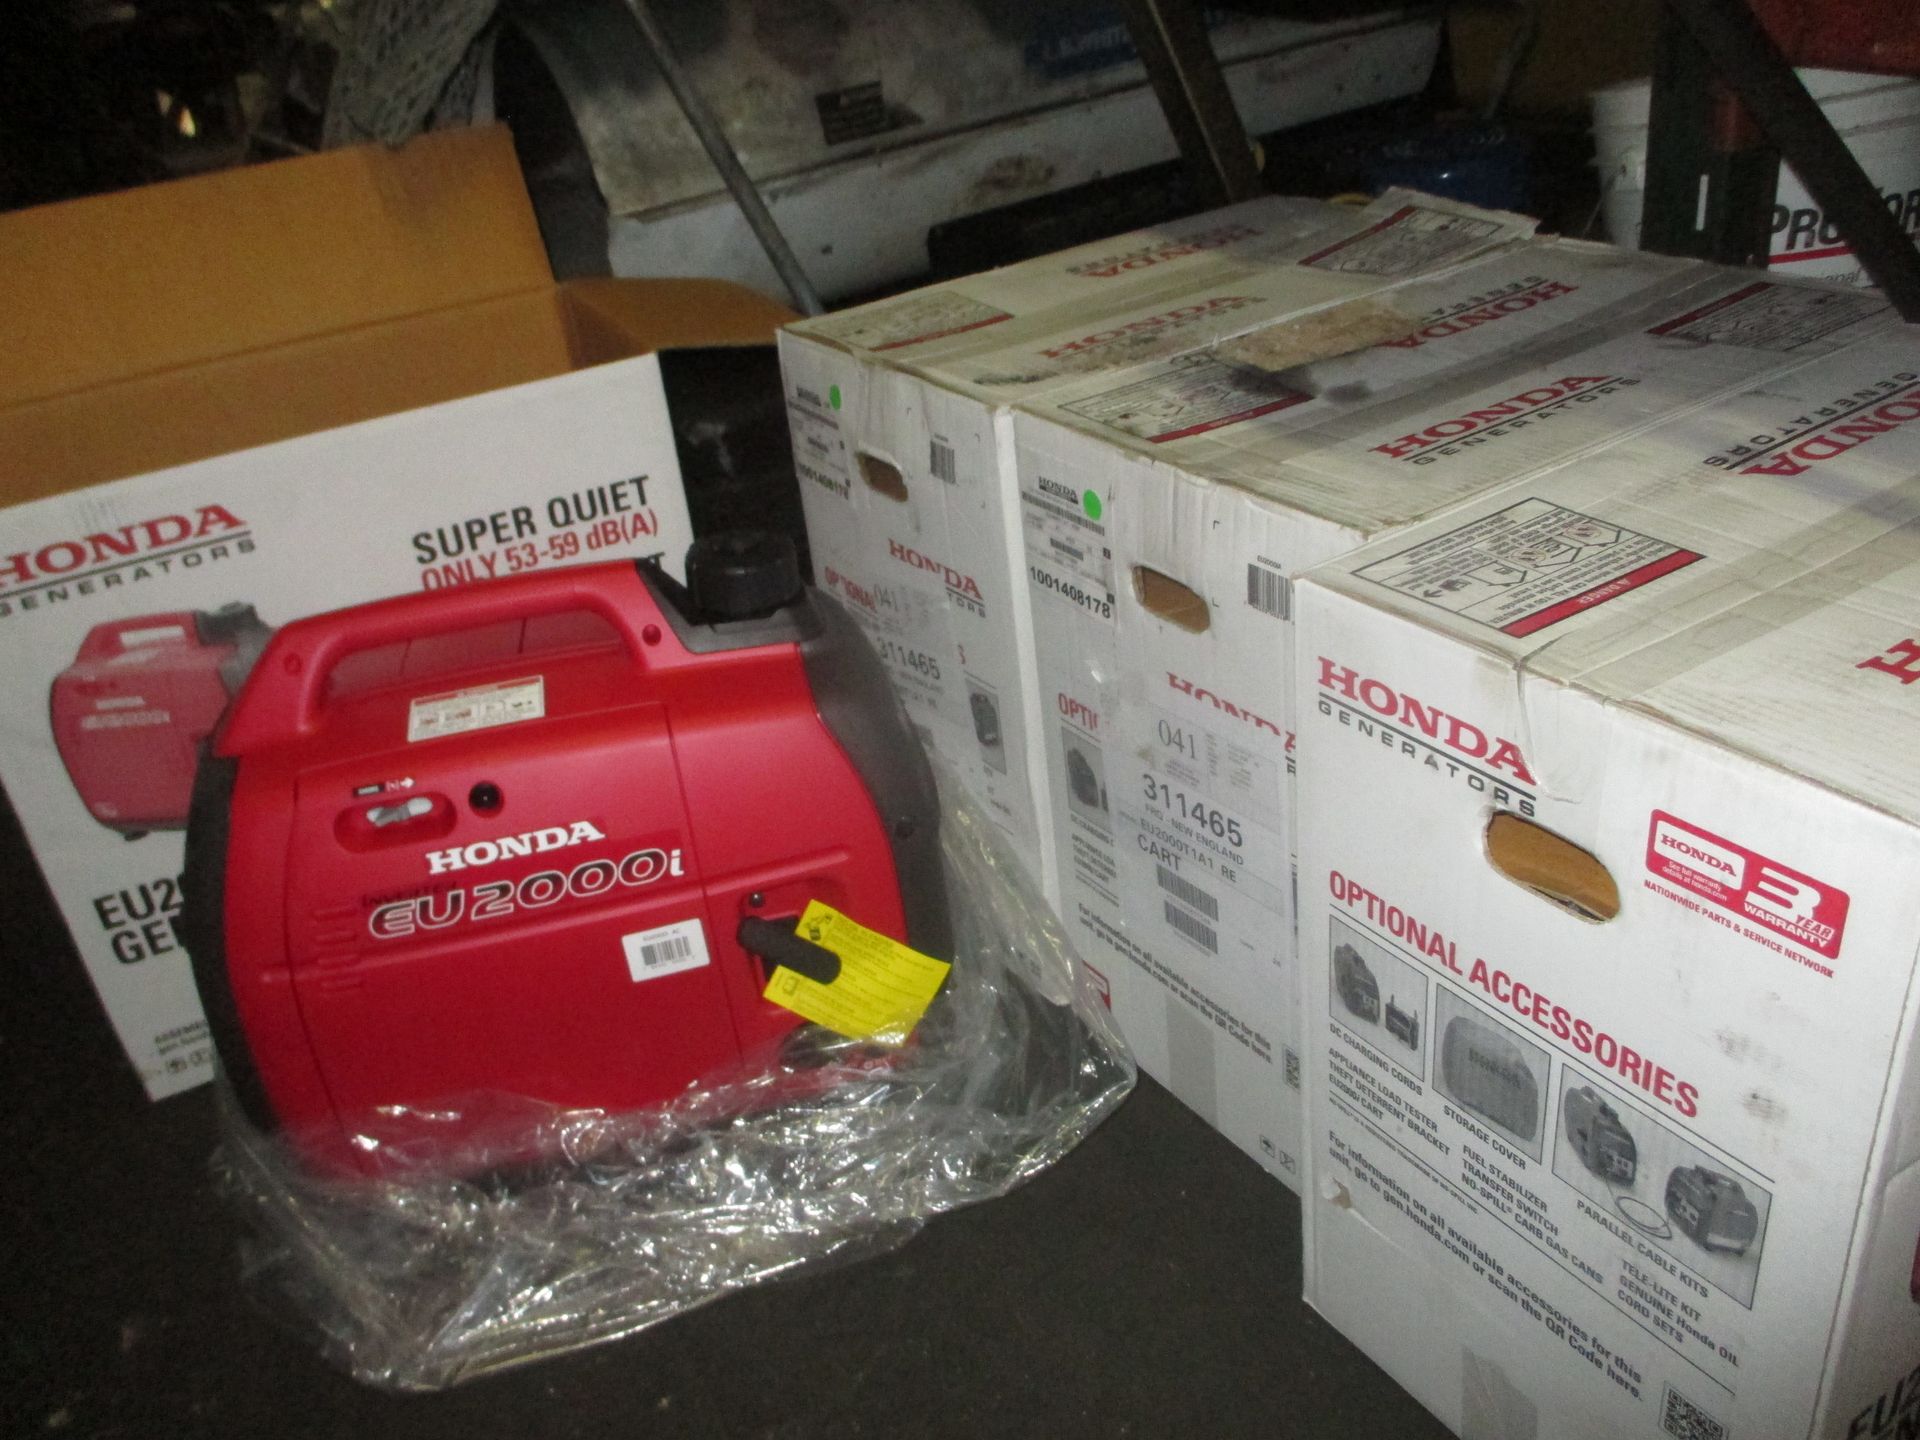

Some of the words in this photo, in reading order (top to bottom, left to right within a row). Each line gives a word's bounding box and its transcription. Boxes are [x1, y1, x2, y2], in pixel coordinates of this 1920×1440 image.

[1371, 282, 1578, 349] HONDA
[1368, 375, 1612, 459] HONDA
[1412, 378, 1641, 466] GENERATORS
[1703, 373, 1918, 468] GENERATORS
[1738, 391, 1920, 477] ONDA
[412, 506, 538, 565] SUPER
[547, 474, 649, 529] QUIET
[1038, 476, 1079, 505] HONDA
[421, 551, 498, 592] ONLY
[504, 531, 580, 572] 53-59
[586, 507, 659, 551] dB(A)
[889, 538, 984, 601] HONDA
[1031, 566, 1111, 620] 1001408178
[1158, 718, 1197, 760] 041
[1317, 655, 1537, 786] HONDA
[1318, 698, 1537, 818] GENERATORS
[425, 820, 606, 875] HONDA
[1143, 773, 1243, 848] 311465
[1137, 834, 1182, 871] CART
[1196, 832, 1244, 866] ENGLAND
[1221, 864, 1237, 883] RE
[1661, 833, 1737, 877] HONDA
[368, 848, 685, 940] EU2000i
[1644, 878, 1699, 913] NATIONWIDE
[1702, 907, 1731, 928] PARTS
[1733, 922, 1741, 933] &
[1743, 927, 1782, 953] SERVICE
[1784, 947, 1833, 978] NETWORK
[1743, 902, 1828, 949] WARRANTY
[1796, 913, 1832, 940] YEAR
[1330, 870, 1463, 976] OPTIONAL
[1467, 955, 1701, 1120] ACCESSORIES
[1329, 1046, 1375, 1087] APPLIANCE
[1378, 1081, 1401, 1106] LOAD
[1404, 1100, 1437, 1133] TESTER
[1330, 1022, 1341, 1038] DC
[1343, 1032, 1388, 1072] CHARGING
[1391, 1066, 1422, 1096] CORDS
[1329, 1059, 1352, 1084] THEFT
[1355, 1079, 1405, 1124] DETERRENT
[1407, 1117, 1449, 1156] BRACKET
[1361, 1096, 1383, 1121] CART
[1443, 1103, 1489, 1145] STORAGE
[1492, 1138, 1525, 1170] COVER
[1462, 1157, 1513, 1203] TRANSFER
[1516, 1198, 1558, 1236] SWITCH
[1463, 1143, 1486, 1169] FUEL
[1489, 1163, 1547, 1213] STABILIZER
[1329, 1129, 1344, 1151] For
[1348, 1144, 1409, 1203] information
[1413, 1197, 1426, 1216] on
[1430, 1209, 1443, 1230] all
[1447, 1222, 1503, 1278] available
[1507, 1272, 1587, 1343] accessories
[1591, 1334, 1611, 1361] for
[1614, 1352, 1640, 1385] this
[1354, 1166, 1367, 1186] go
[1370, 1177, 1380, 1193] to
[1383, 1187, 1468, 1265] gen.honda.com
[1472, 1261, 1484, 1278] or
[1488, 1272, 1517, 1304] scan
[1521, 1296, 1541, 1322] the
[1545, 1315, 1564, 1342] QR
[1568, 1332, 1602, 1371] Code
[1607, 1362, 1642, 1403] here.
[1515, 1212, 1542, 1240] CARB
[1546, 1235, 1568, 1259] GAS
[1571, 1254, 1603, 1285] CANS
[1577, 1198, 1633, 1247] PARALLEL
[1637, 1241, 1675, 1276] CABLE
[1679, 1270, 1707, 1299] KITS
[1617, 1287, 1649, 1319] CORD
[1653, 1313, 1683, 1344] SETS
[1620, 1273, 1673, 1320] GENUINE
[1676, 1315, 1714, 1351] Honda
[1718, 1344, 1738, 1367] OIL
[1622, 1258, 1677, 1306] TELE-LITE
[1680, 1300, 1700, 1324] KIT
